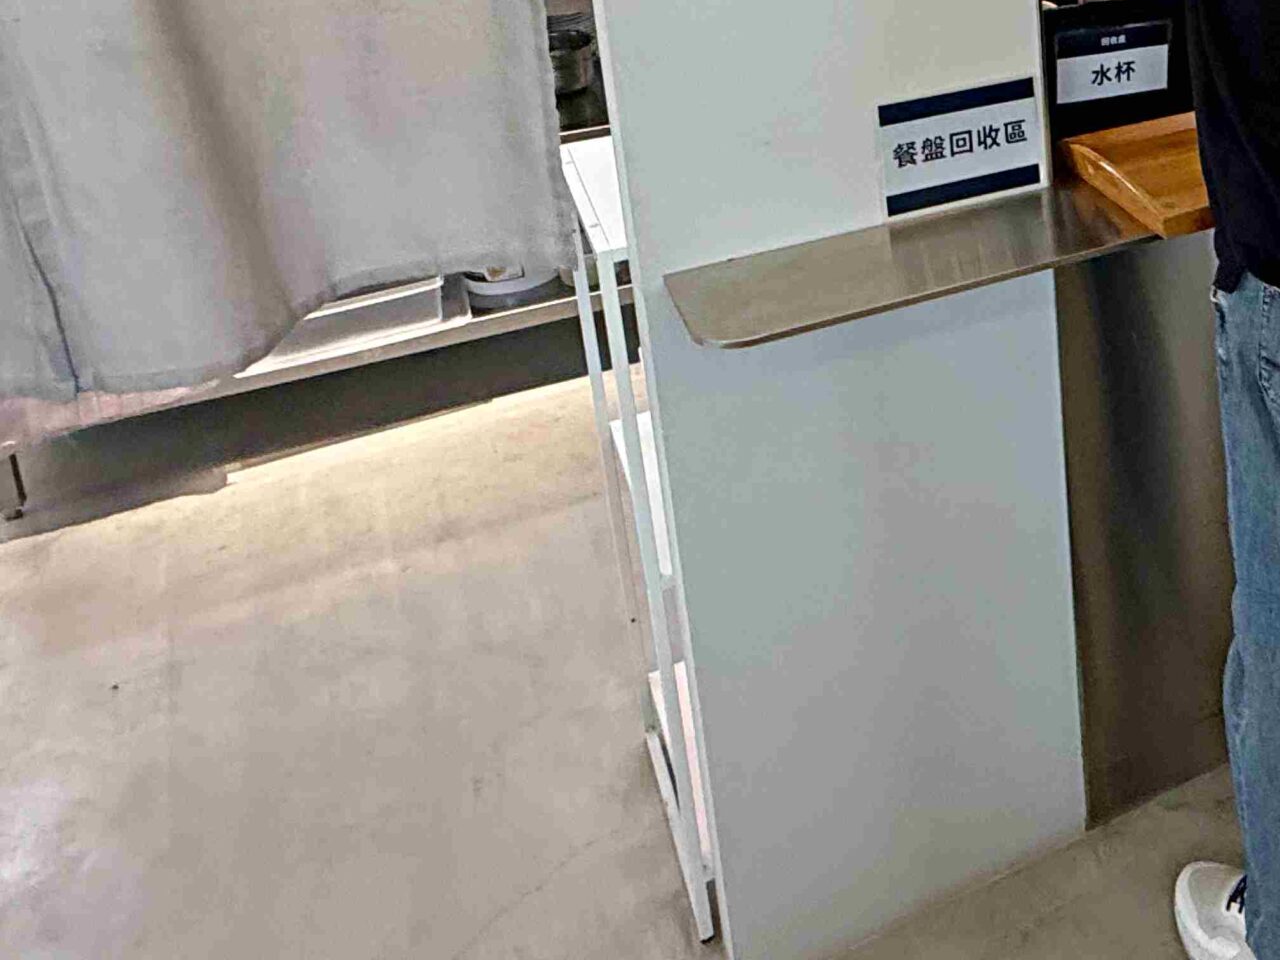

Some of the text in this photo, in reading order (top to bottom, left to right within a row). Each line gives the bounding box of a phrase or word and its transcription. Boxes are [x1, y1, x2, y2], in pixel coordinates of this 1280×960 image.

[1091, 61, 1135, 86] 水杯
[893, 119, 1028, 168] 餐盤回收區
